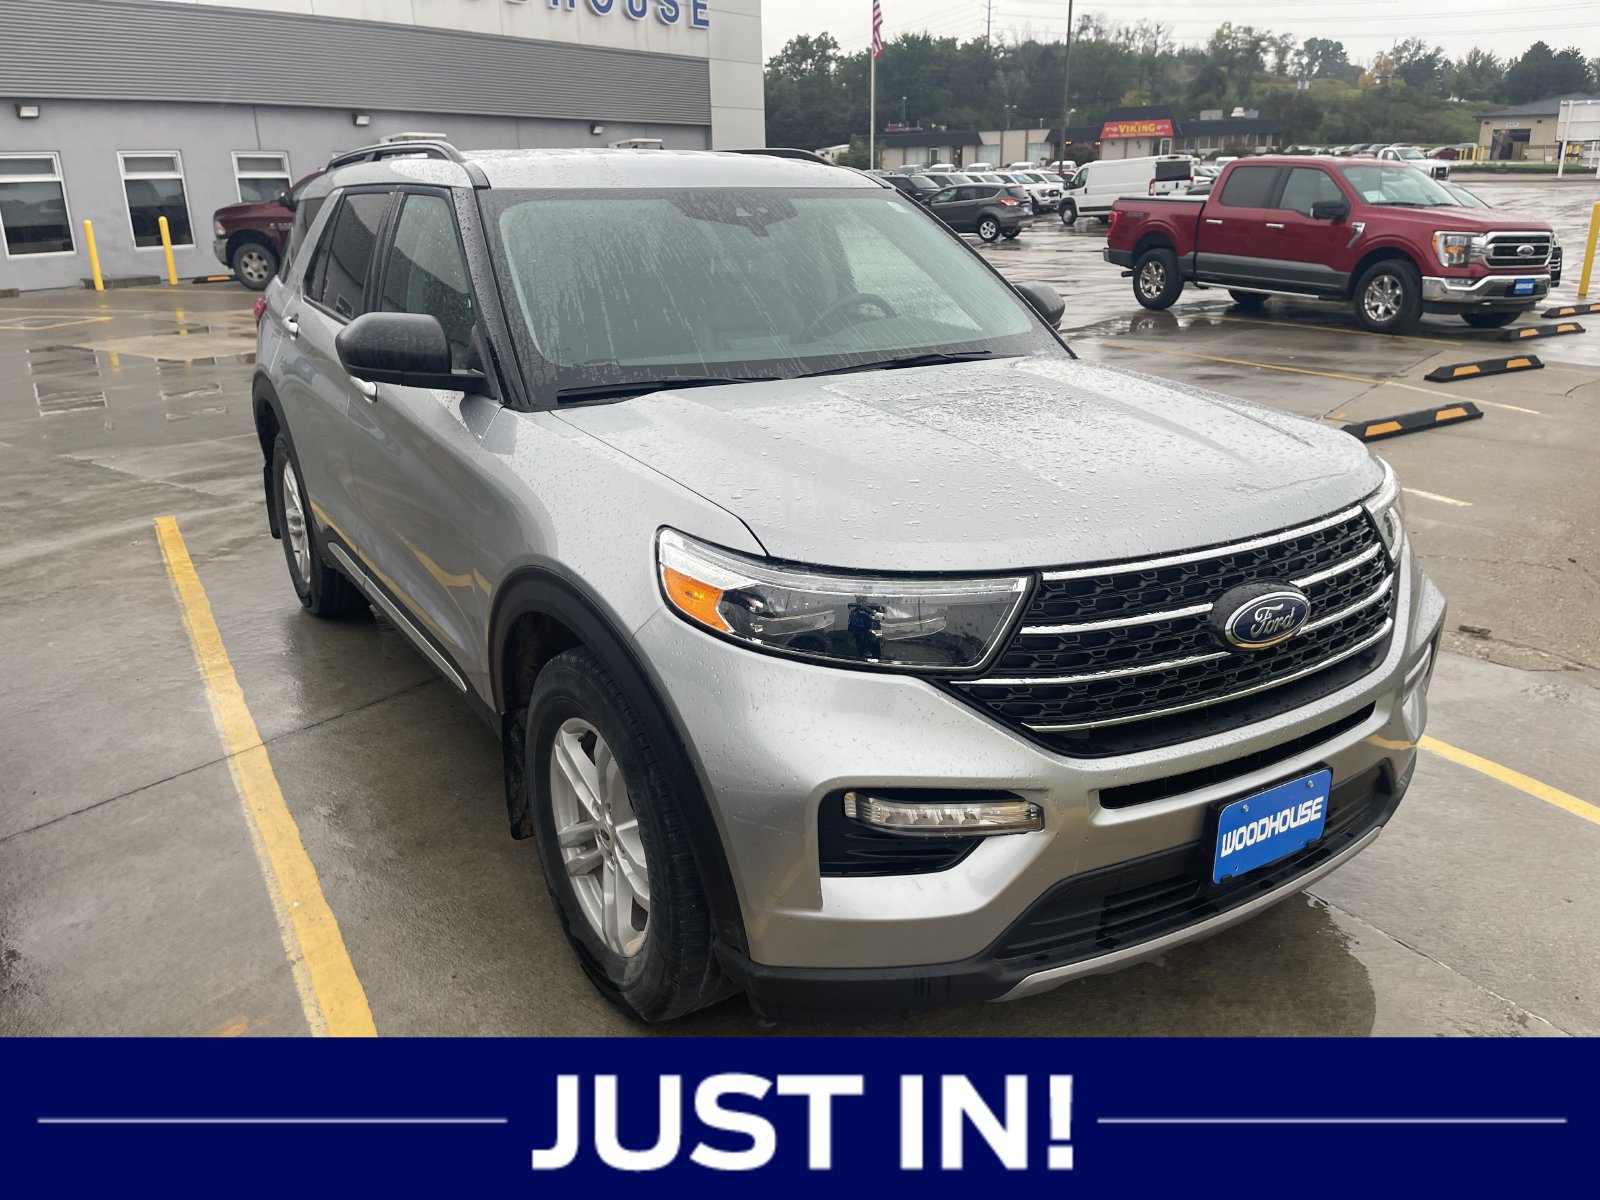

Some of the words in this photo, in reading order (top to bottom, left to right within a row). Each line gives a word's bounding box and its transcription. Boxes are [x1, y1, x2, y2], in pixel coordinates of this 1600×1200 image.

[1118, 123, 1156, 133] VIKING
[1250, 603, 1296, 638] Ford
[1221, 796, 1324, 857] WOODHOUSE
